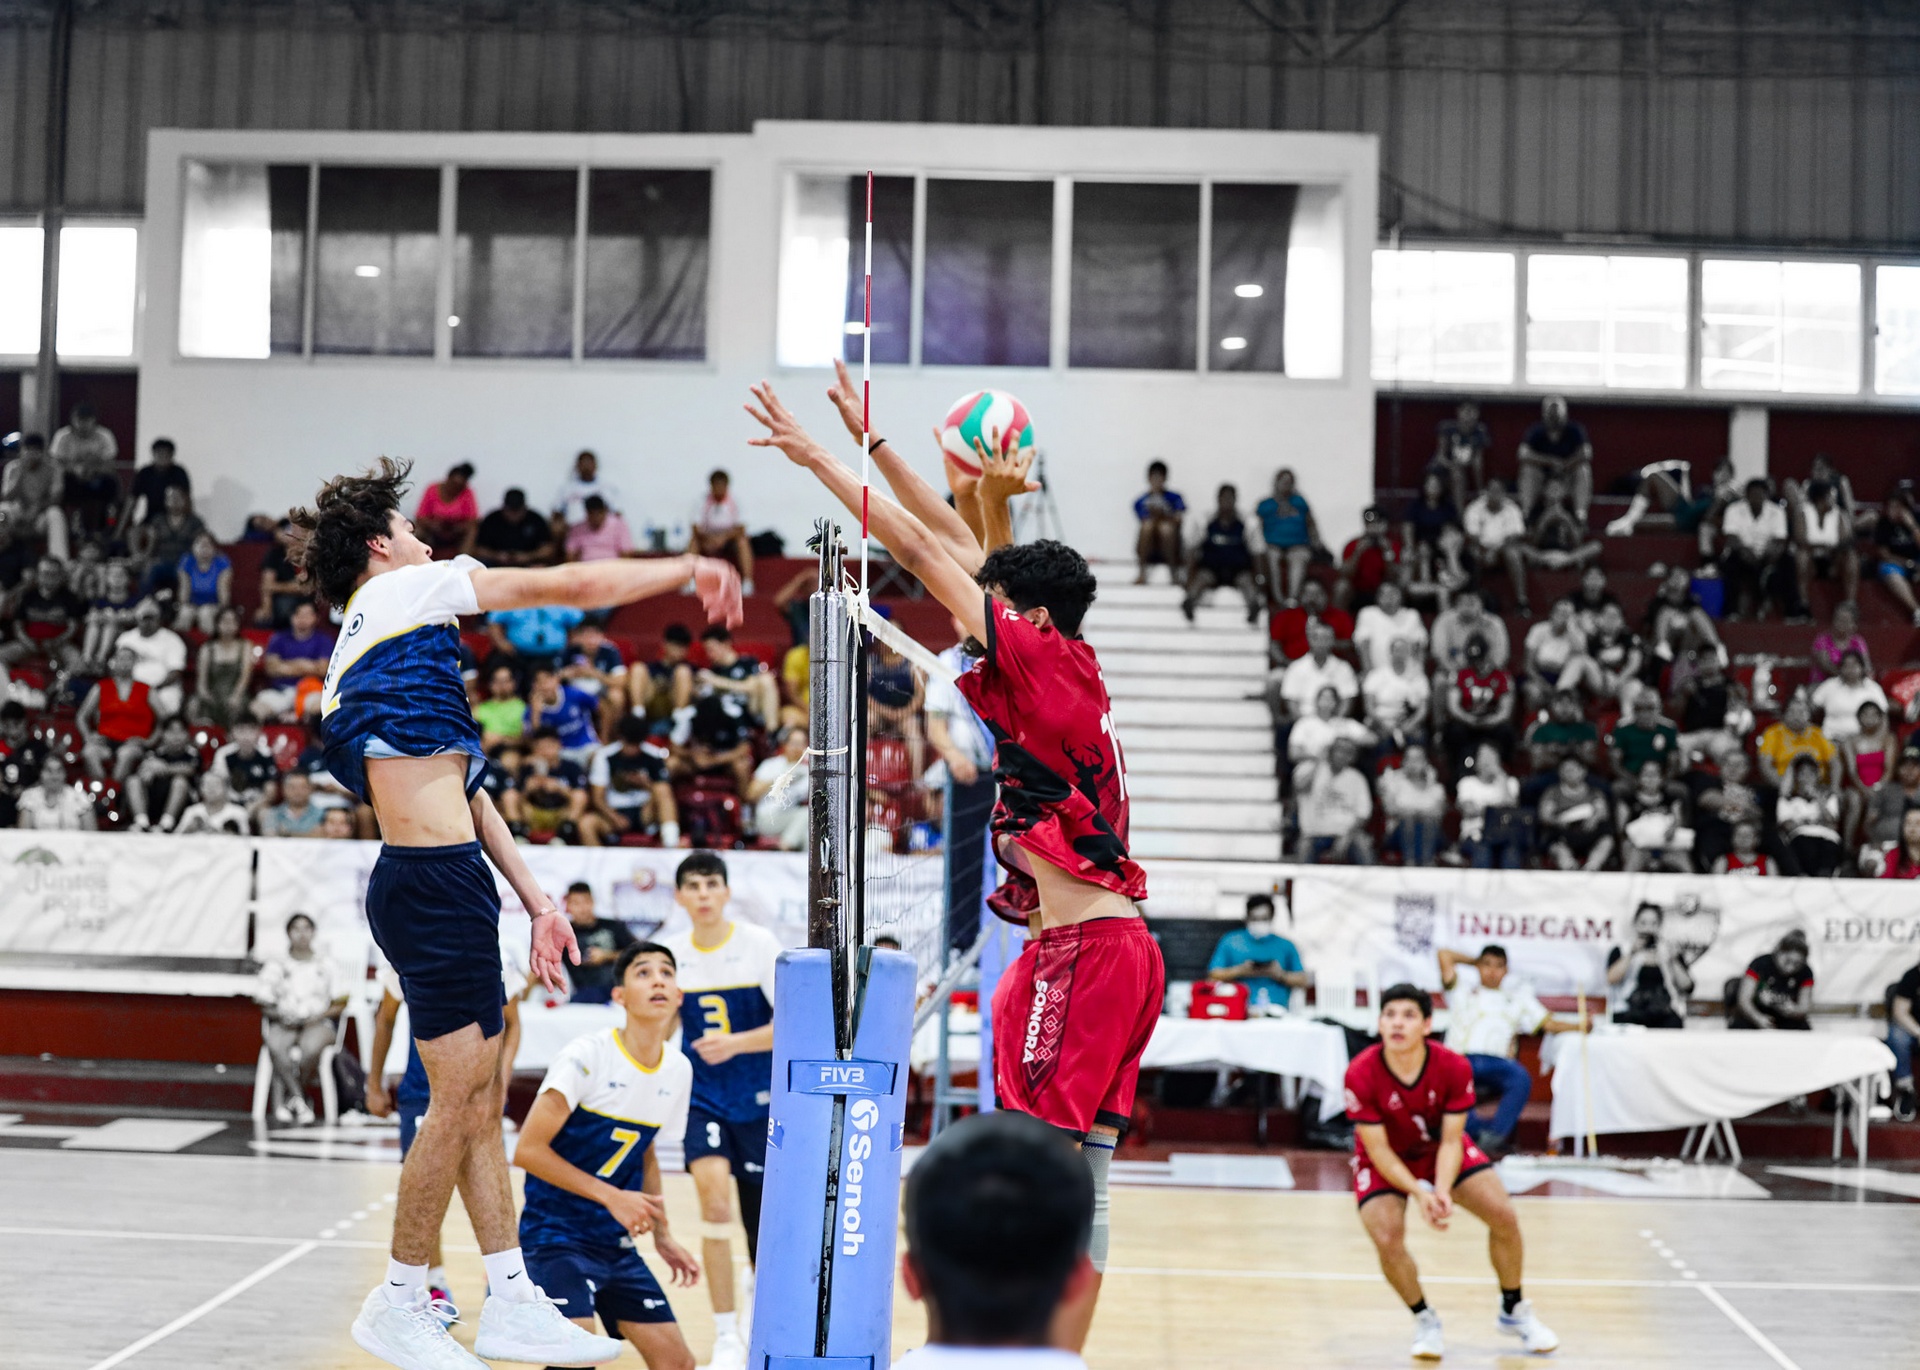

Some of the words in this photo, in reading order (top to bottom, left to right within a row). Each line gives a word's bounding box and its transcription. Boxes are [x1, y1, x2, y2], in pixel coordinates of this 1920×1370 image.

[1458, 911, 1614, 940] INDECAM
[698, 994, 732, 1036] 3
[1023, 979, 1048, 1064] SONORA
[596, 1127, 641, 1178] 7
[842, 1133, 872, 1256] Senoh
